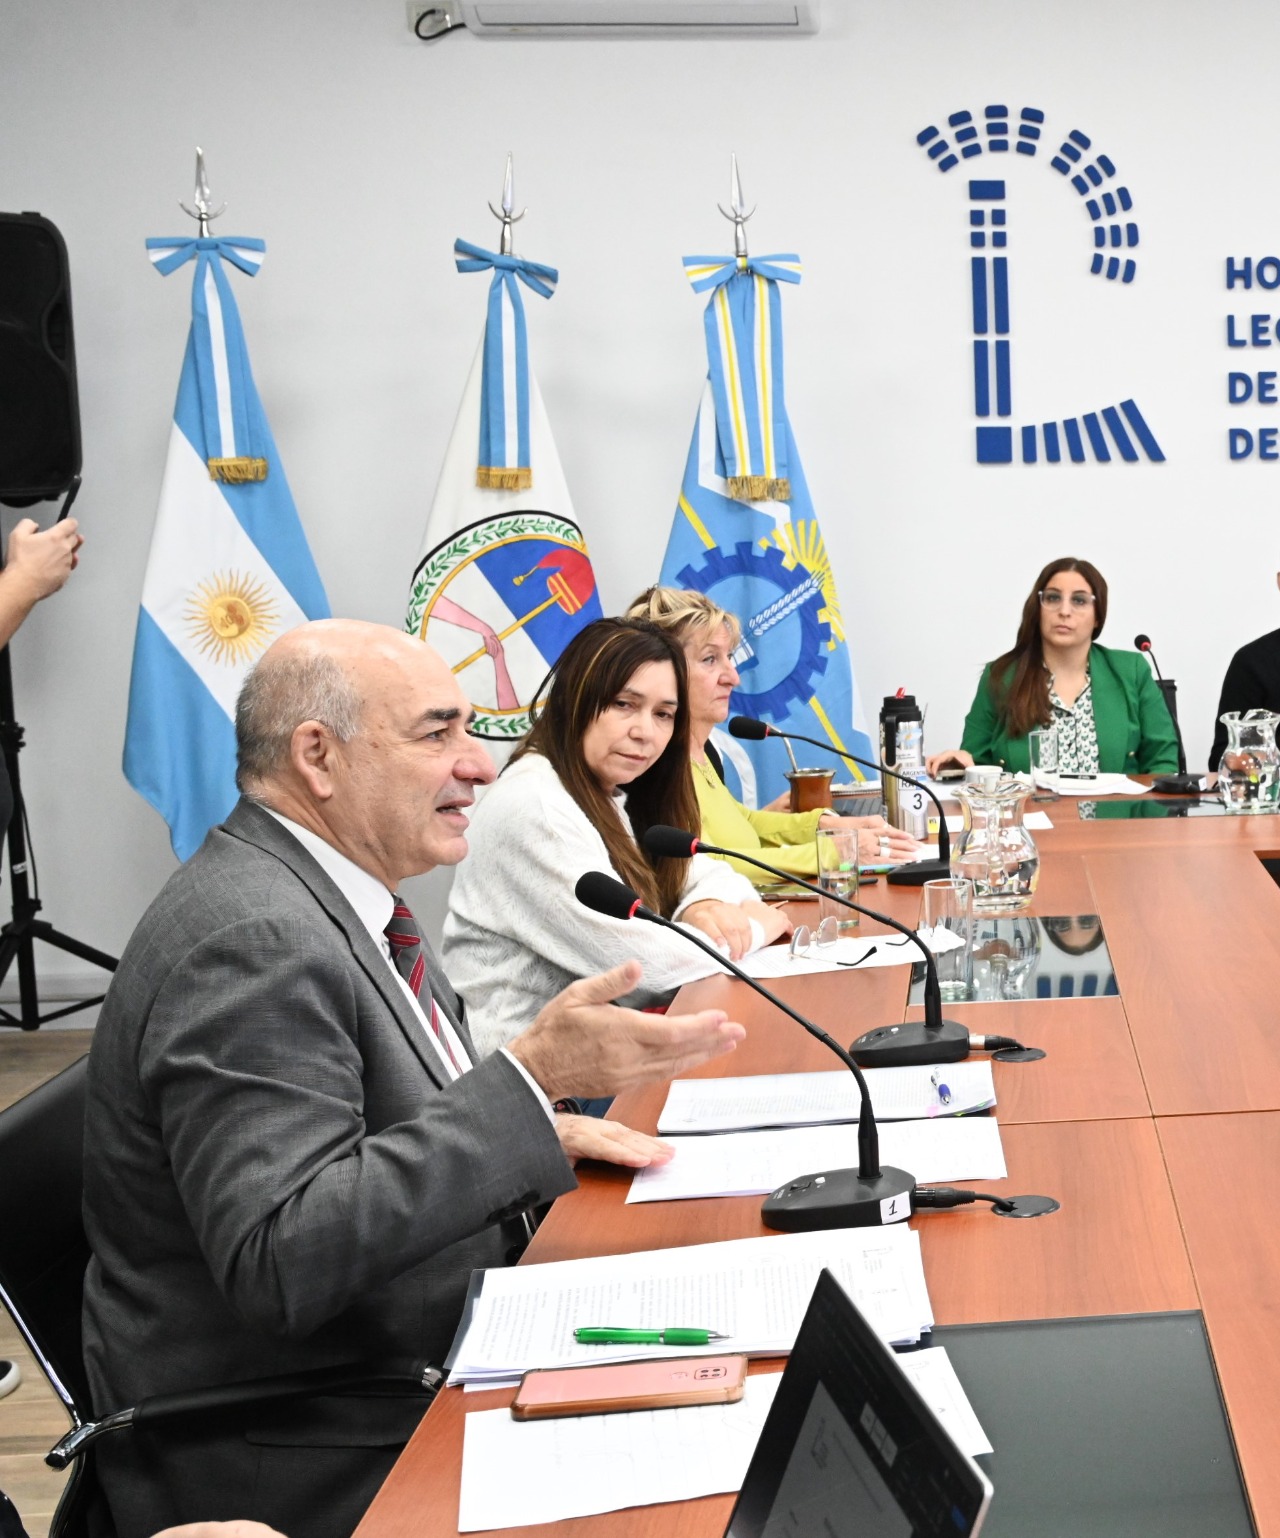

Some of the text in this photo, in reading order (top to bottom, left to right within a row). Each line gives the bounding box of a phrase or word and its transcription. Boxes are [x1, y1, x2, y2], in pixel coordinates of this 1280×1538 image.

[1228, 371, 1278, 404] DE
[912, 792, 923, 810] 3
[888, 1199, 898, 1216] 1
